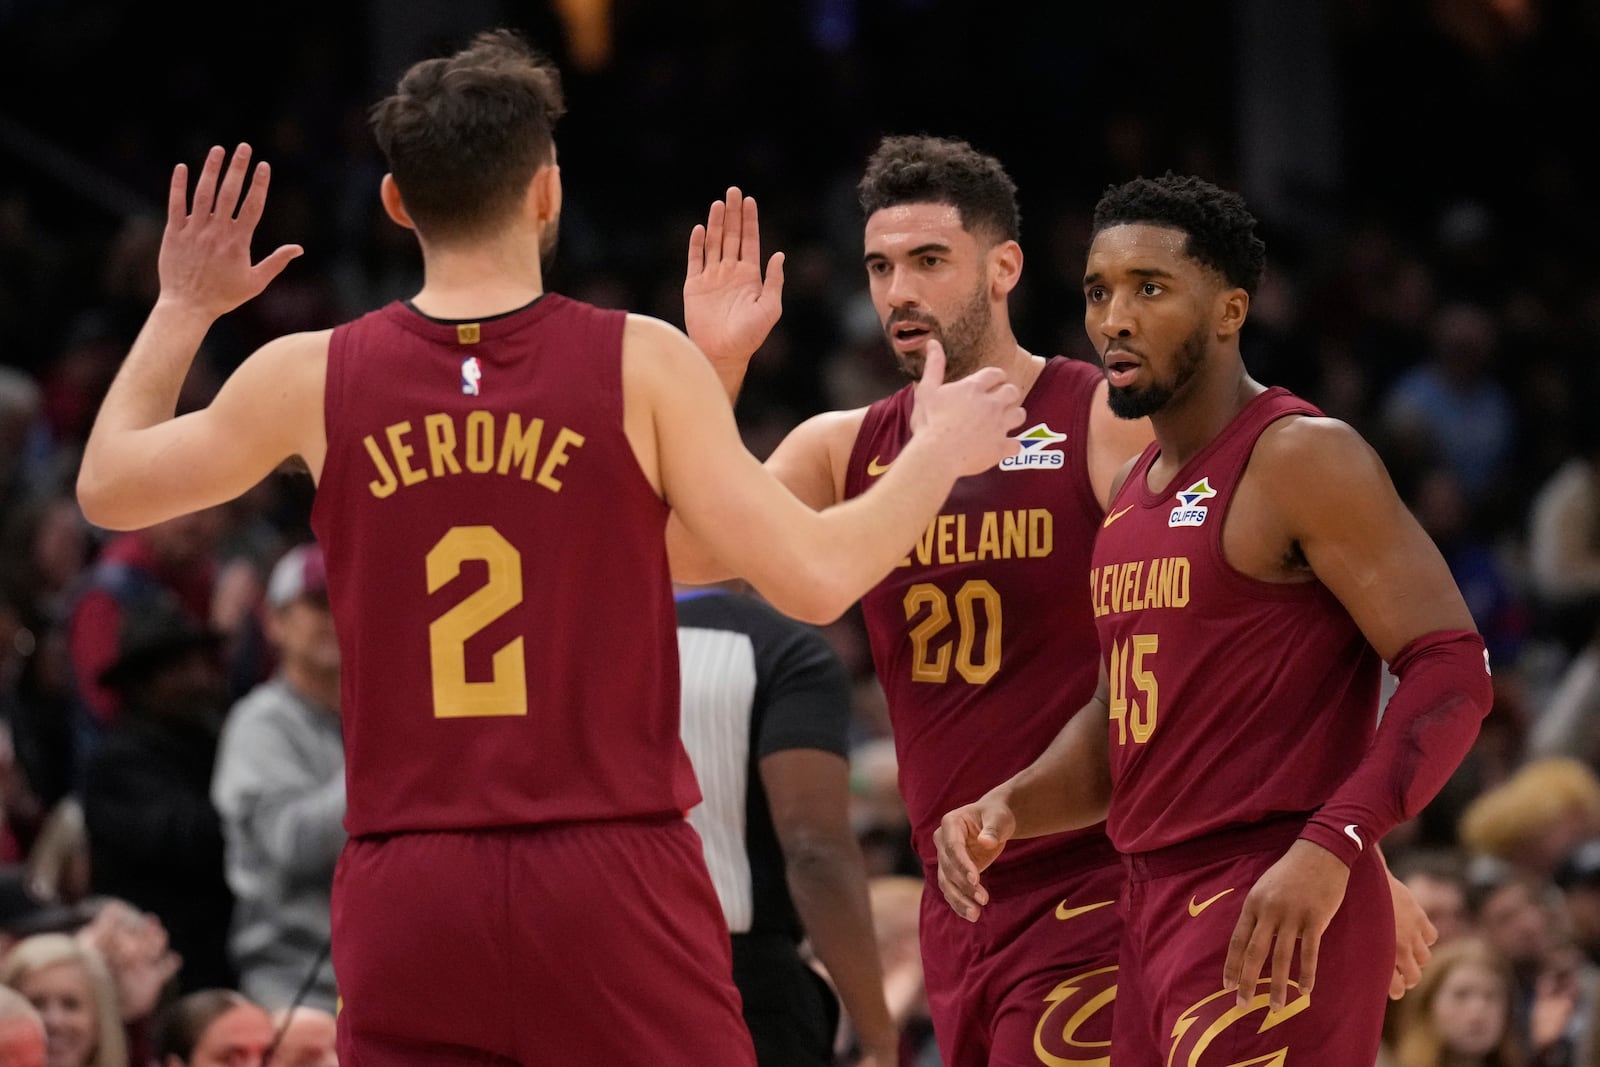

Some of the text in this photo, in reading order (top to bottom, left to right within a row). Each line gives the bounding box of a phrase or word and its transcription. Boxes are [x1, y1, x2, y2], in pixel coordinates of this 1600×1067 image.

[363, 410, 585, 499] JEROME
[1002, 454, 1062, 466] CLIFFS
[894, 508, 1053, 568] VELAND
[1171, 510, 1205, 523] CLIFFS
[425, 525, 527, 719] 2
[903, 579, 1003, 685] 20
[1109, 634, 1159, 745] 45
